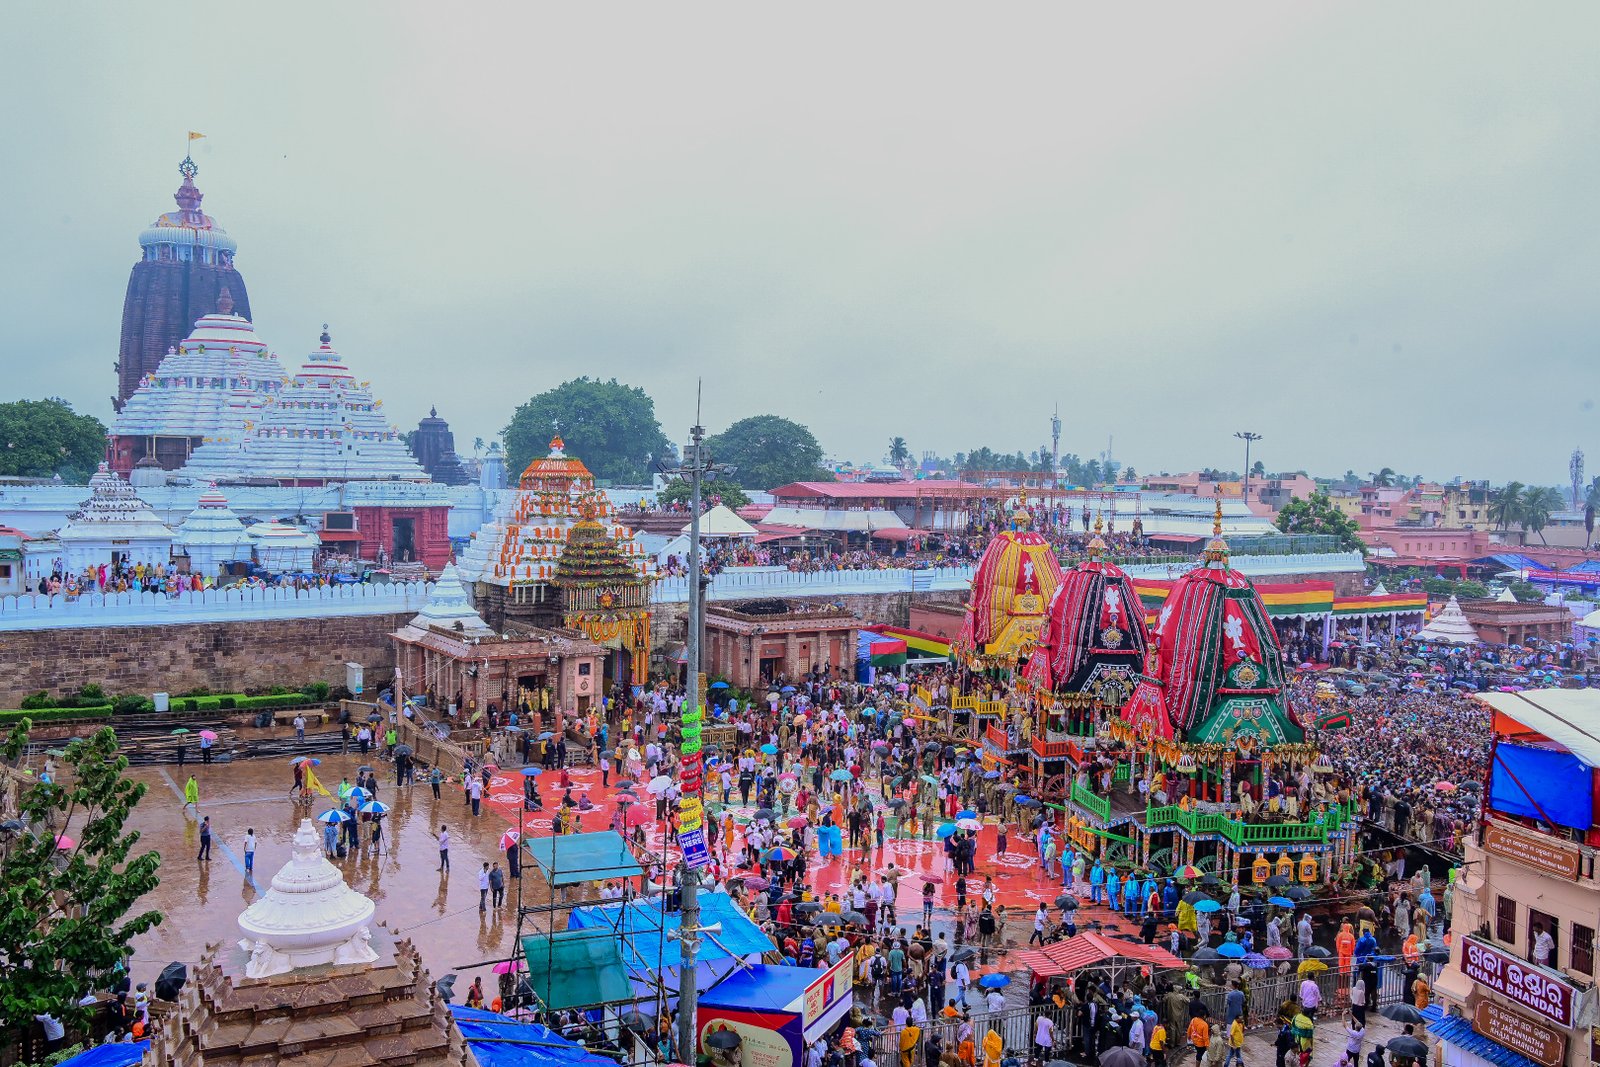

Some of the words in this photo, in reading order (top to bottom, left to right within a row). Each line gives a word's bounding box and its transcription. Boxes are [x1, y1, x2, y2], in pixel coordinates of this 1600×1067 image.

[682, 838, 703, 848] HERE
[1466, 963, 1503, 990] KHAJA
[1506, 983, 1563, 1020] BHANDAR
[1489, 1018, 1500, 1028] JAY
[1501, 1023, 1545, 1050] JAGANNATHA
[1490, 1027, 1510, 1042] KHAJA
[1511, 1036, 1544, 1058] BHANDAR
